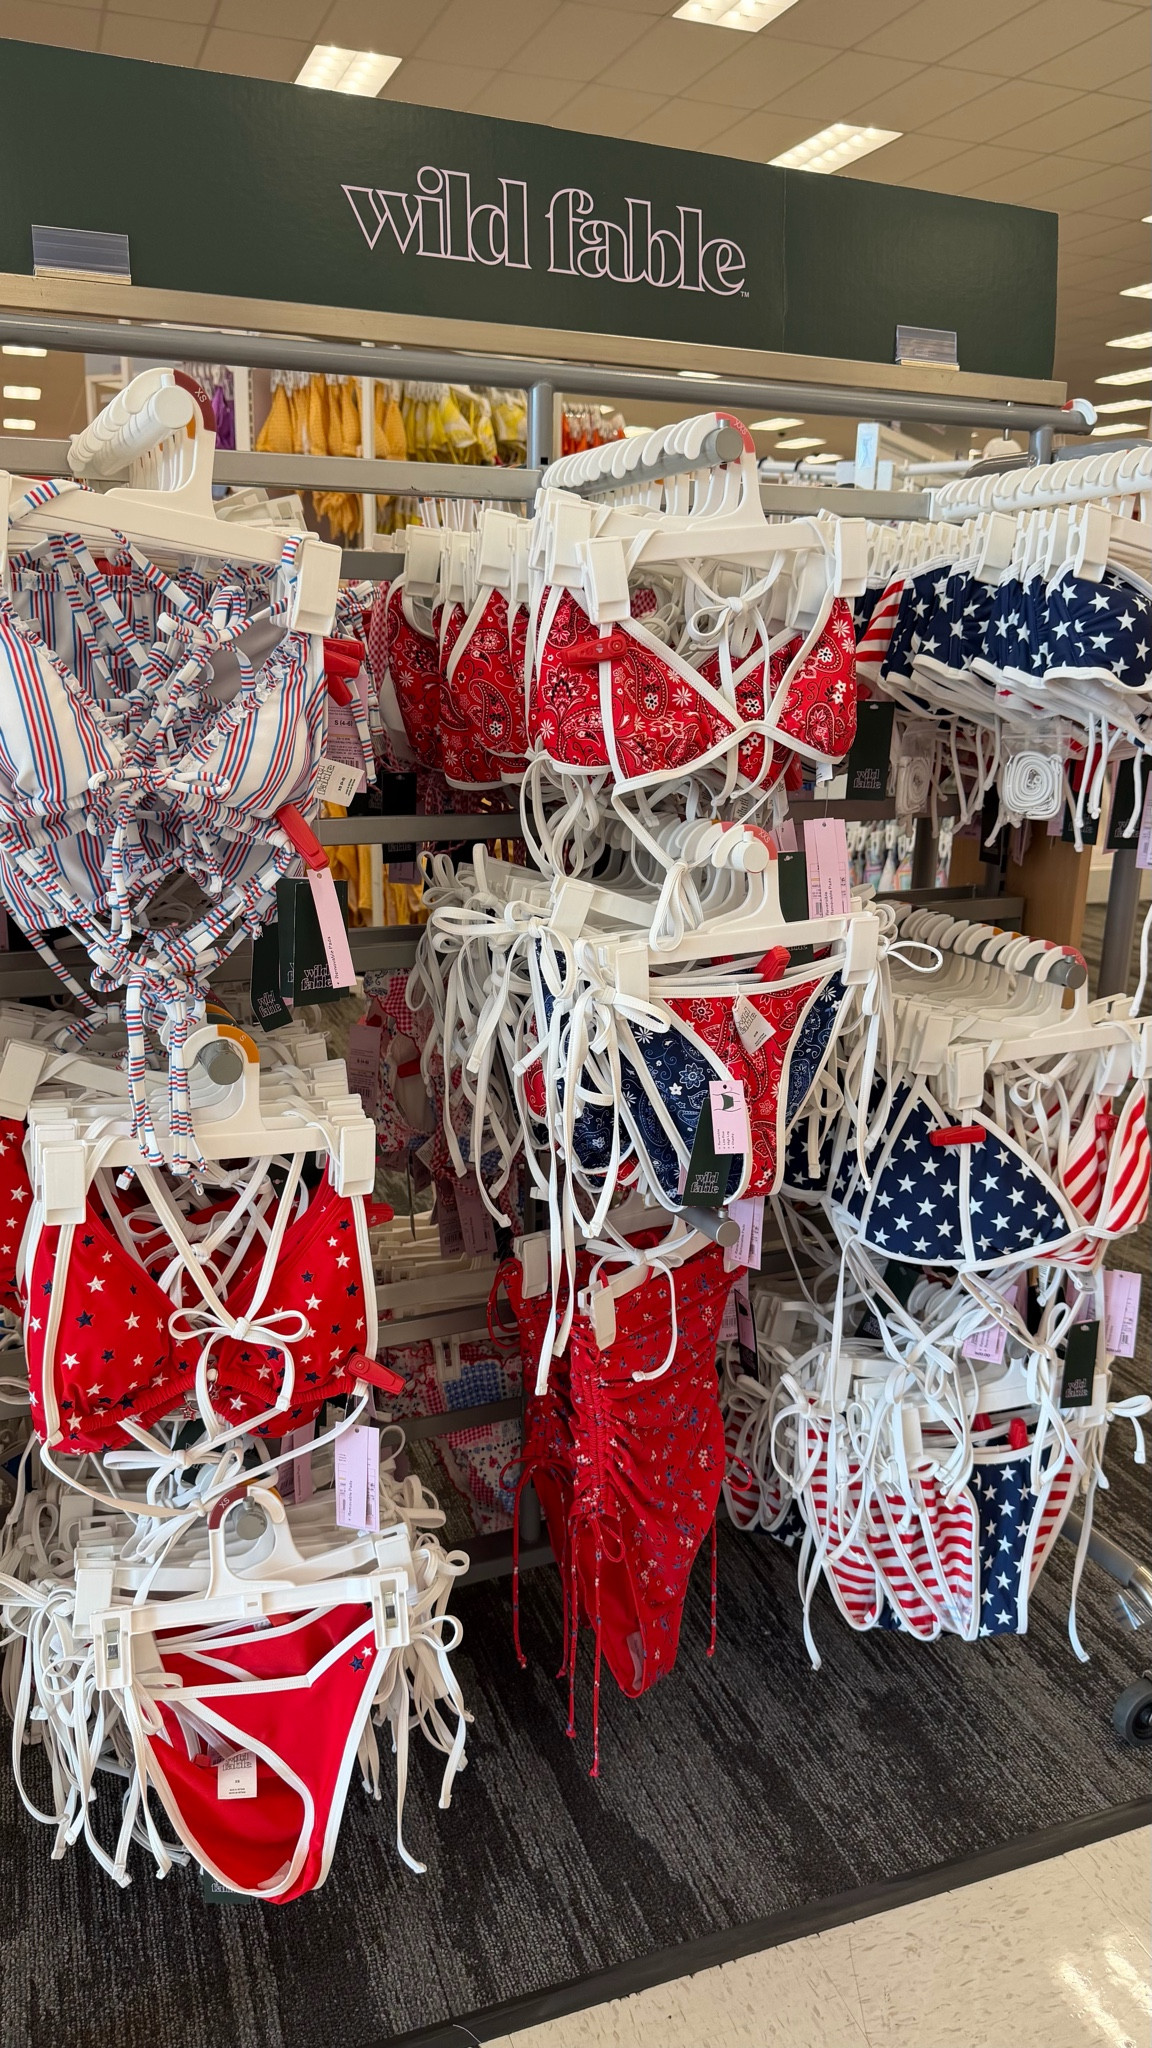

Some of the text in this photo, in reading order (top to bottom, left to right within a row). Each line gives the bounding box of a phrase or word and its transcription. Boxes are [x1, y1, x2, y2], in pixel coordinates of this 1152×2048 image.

[341, 166, 532, 269] wild
[545, 188, 746, 296] fable
[195, 387, 207, 402] XS
[856, 767, 880, 780] wild
[853, 777, 882, 789] fable
[300, 975, 333, 991] fable
[257, 989, 276, 1006] wild
[258, 1001, 282, 1018] fable
[695, 1171, 720, 1184] wild
[690, 1181, 720, 1194] fable
[219, 1497, 230, 1509] XS
